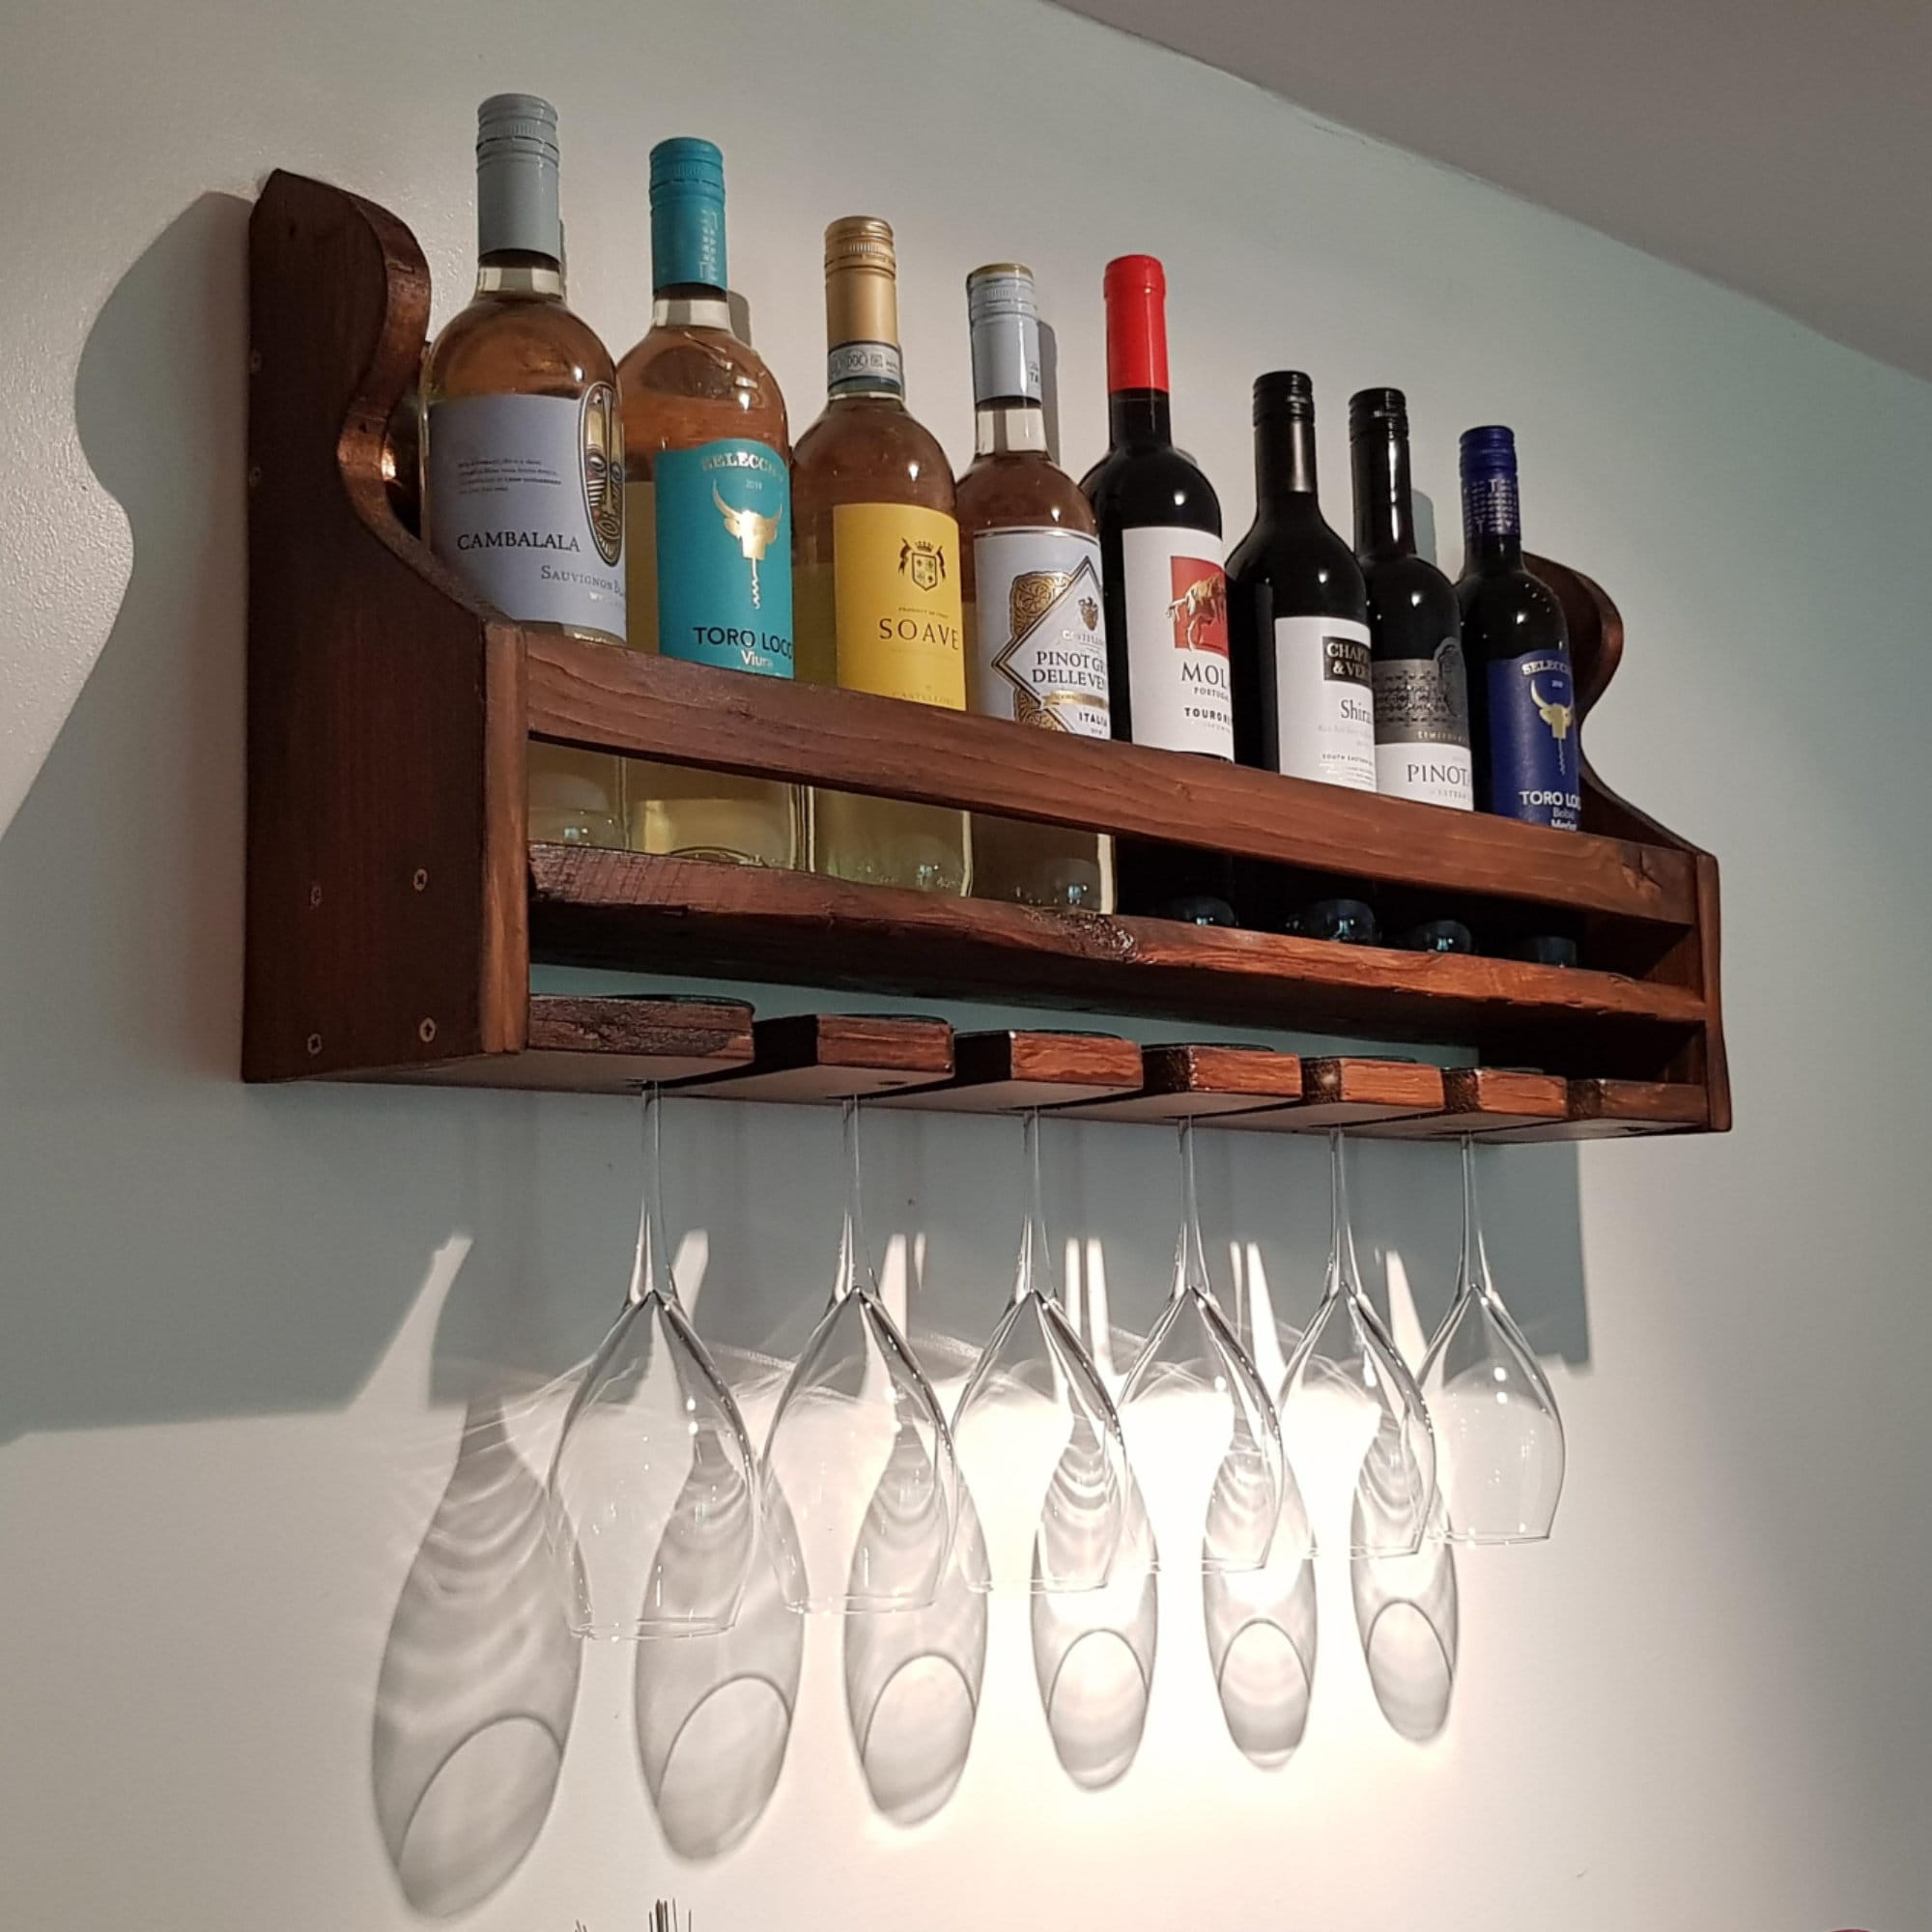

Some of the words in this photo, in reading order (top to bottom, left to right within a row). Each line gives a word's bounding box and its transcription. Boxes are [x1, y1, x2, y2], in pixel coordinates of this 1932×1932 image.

[457, 531, 580, 553] CAMBALALA
[693, 626, 755, 648] TORO
[879, 618, 959, 650] SOAVE
[1037, 651, 1090, 668] PINOT
[1333, 659, 1346, 675] &
[1032, 668, 1087, 686] DELLE
[1519, 790, 1564, 806] TORO
